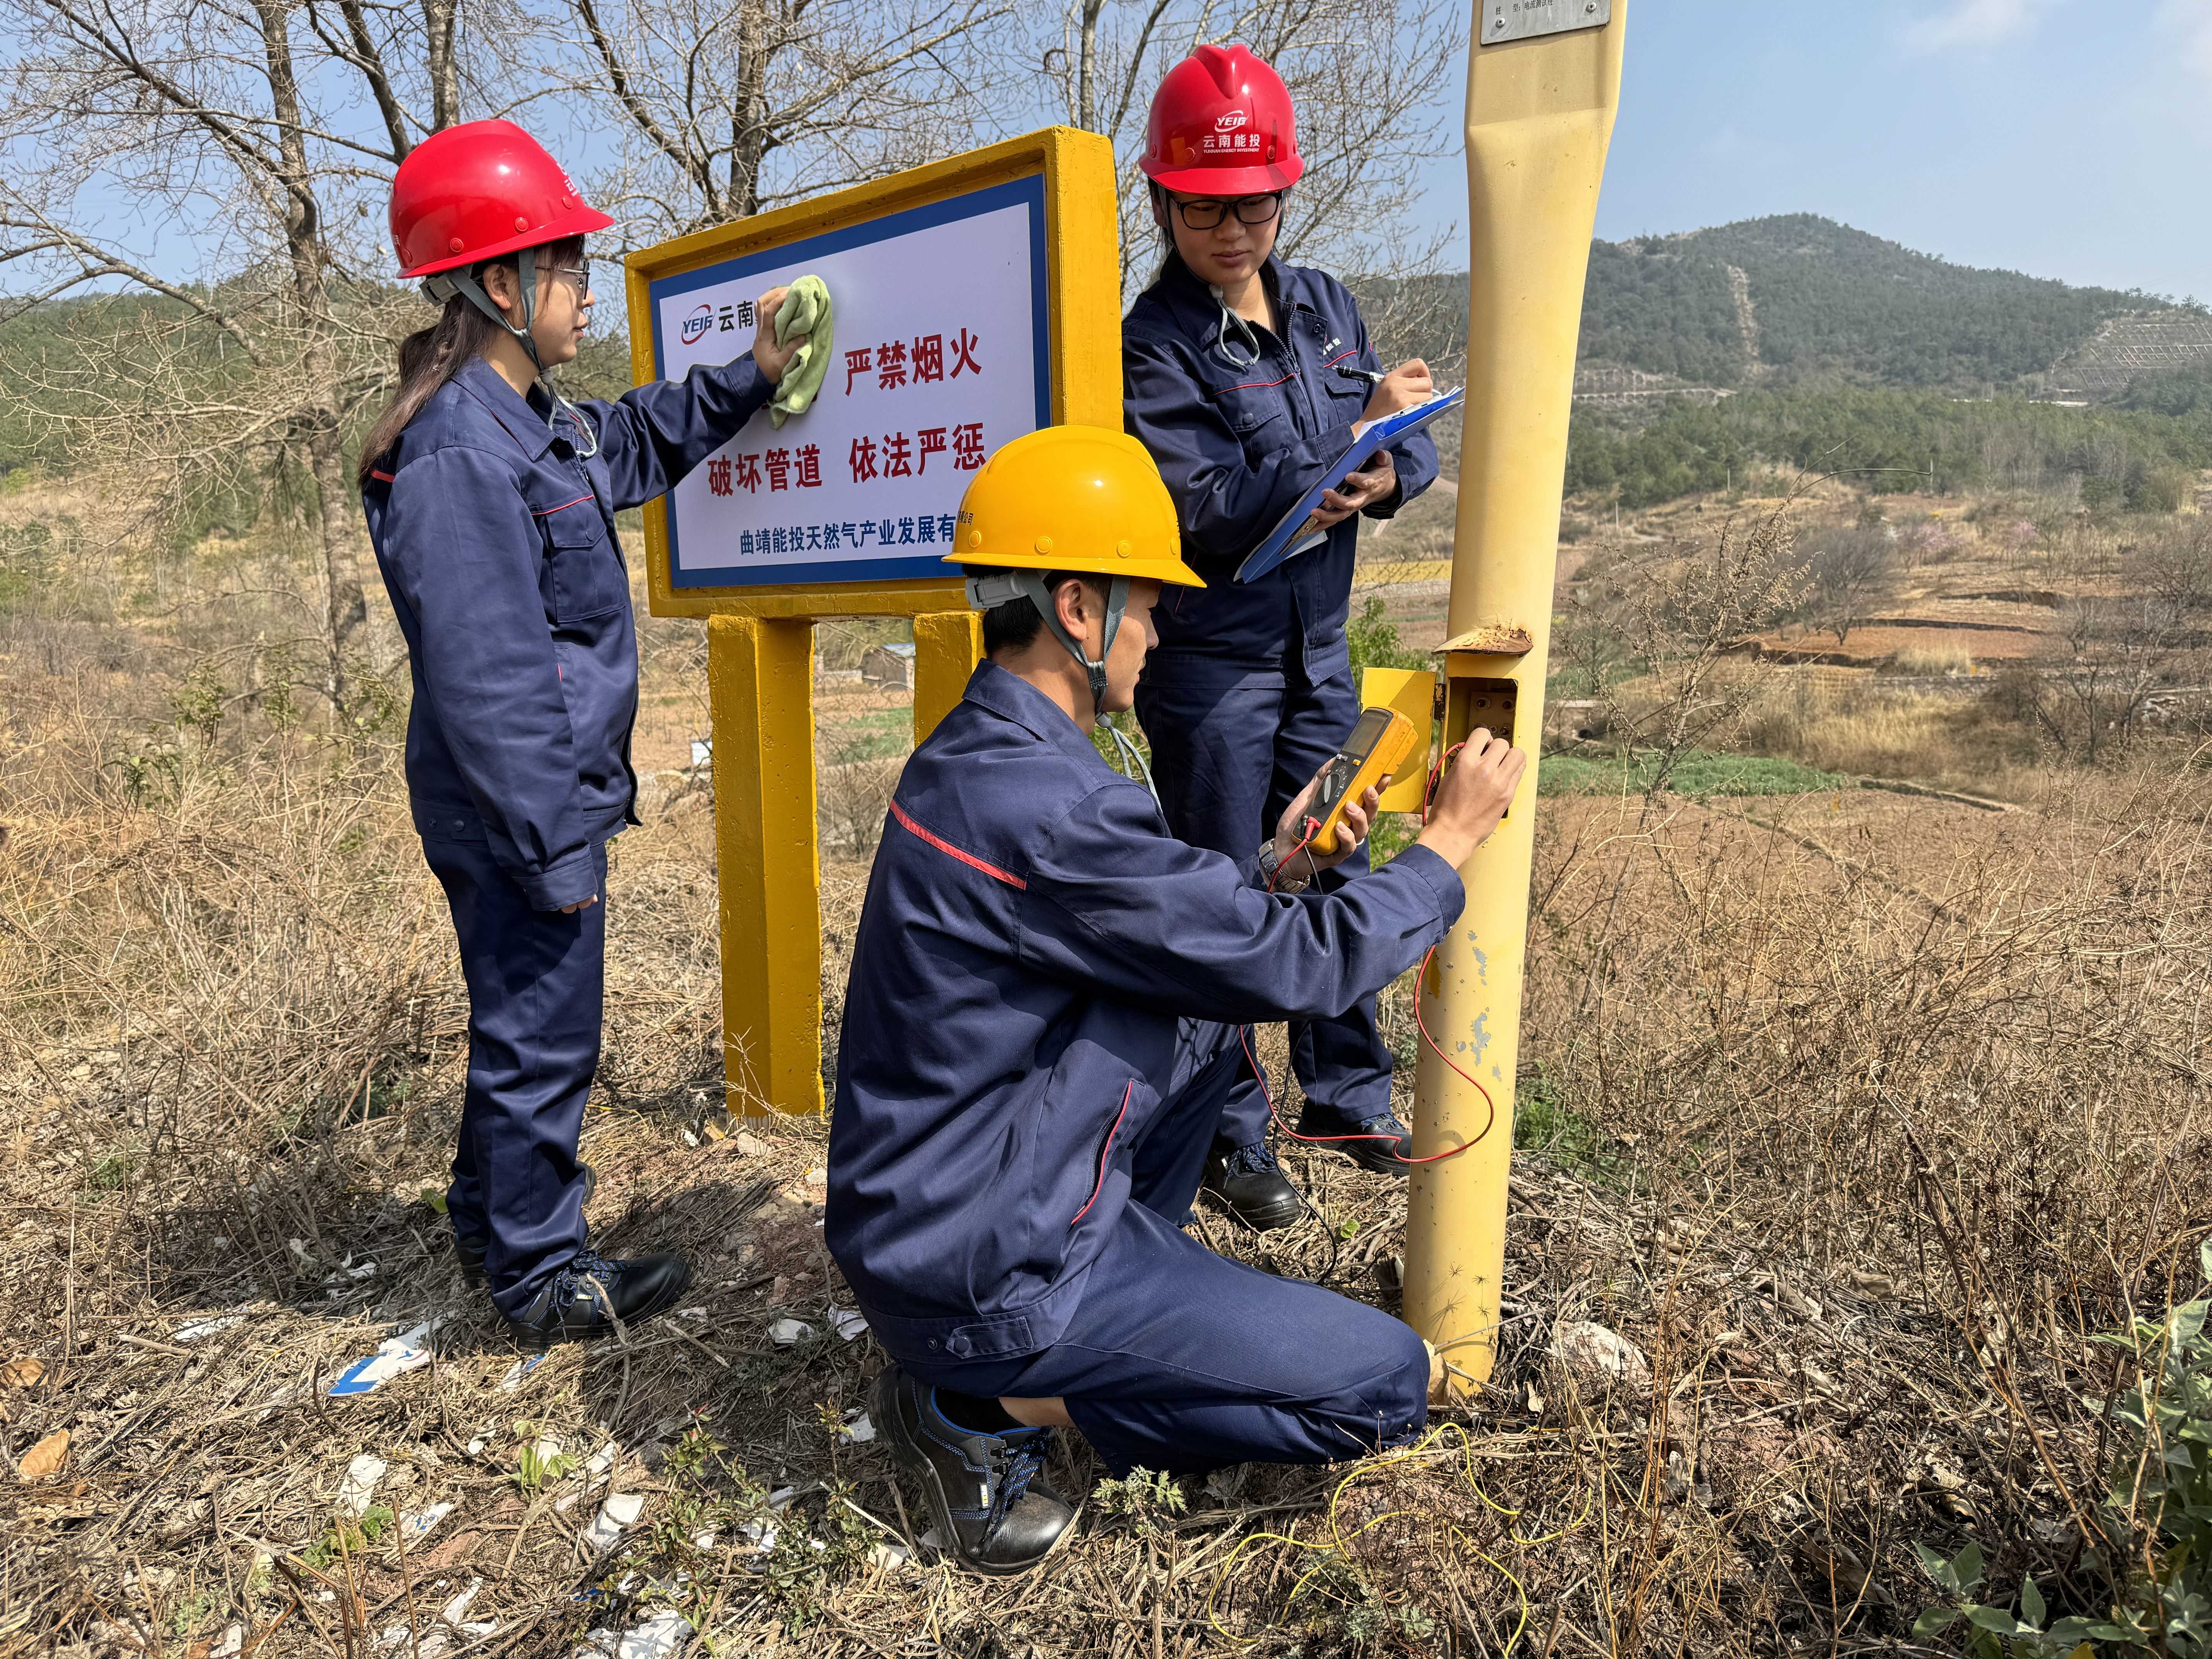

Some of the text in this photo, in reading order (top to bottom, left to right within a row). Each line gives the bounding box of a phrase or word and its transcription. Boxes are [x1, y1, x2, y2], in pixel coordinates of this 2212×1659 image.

[1217, 117, 1247, 126] YEIG
[1203, 134, 1260, 148] 云南能投
[683, 315, 713, 334] YEIG
[719, 301, 758, 332] 云南
[845, 328, 982, 397] 严禁烟火
[708, 422, 986, 497] 破坏管道 依法严惩
[740, 513, 956, 555] 曲靖能投天然气产业发展有
